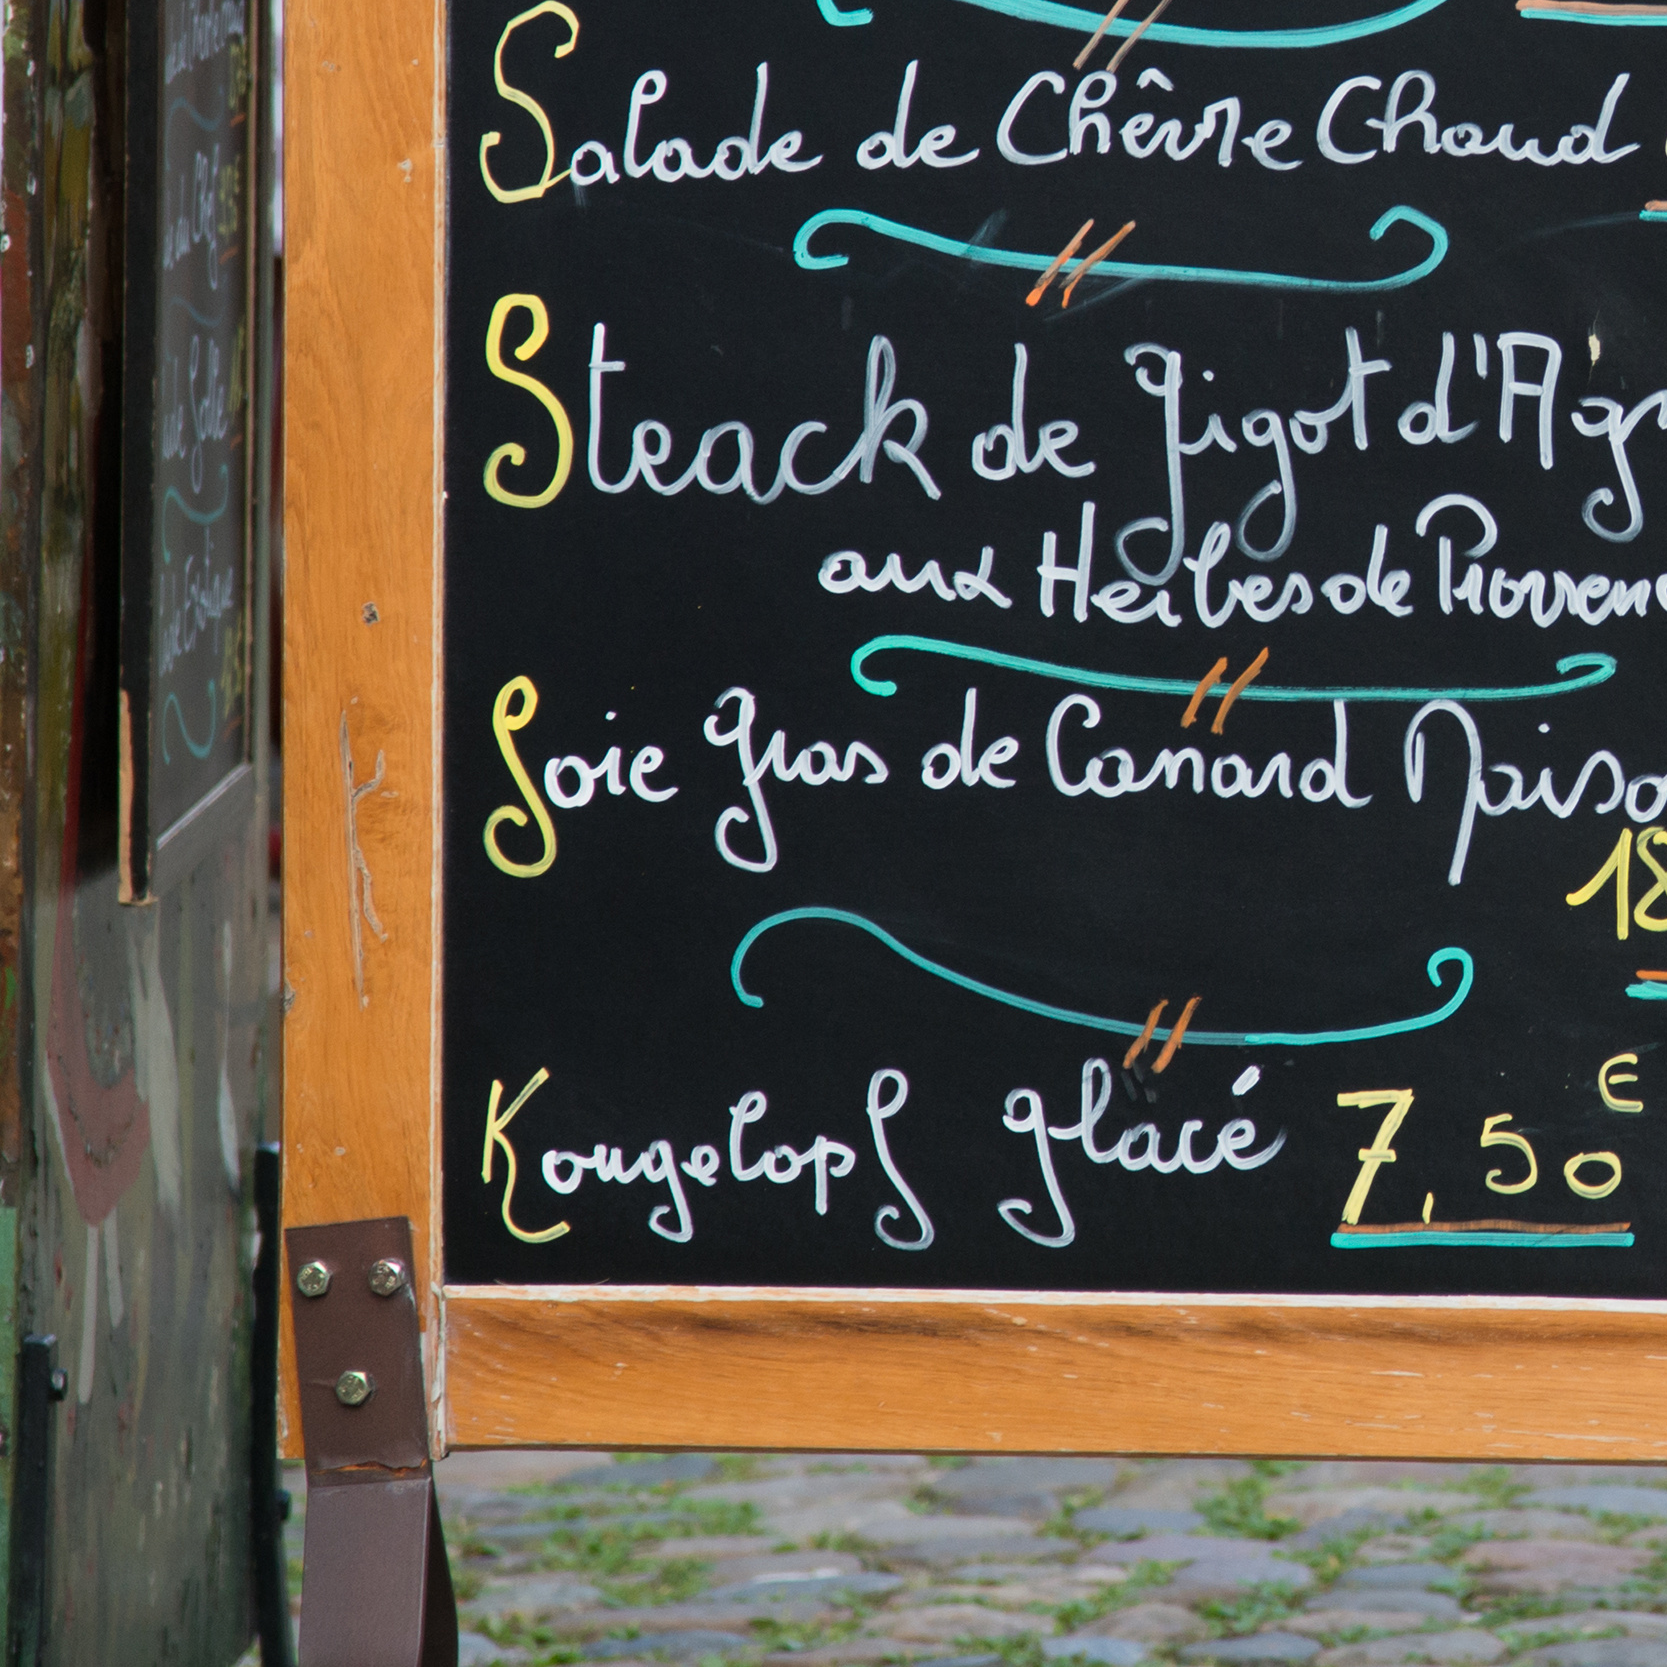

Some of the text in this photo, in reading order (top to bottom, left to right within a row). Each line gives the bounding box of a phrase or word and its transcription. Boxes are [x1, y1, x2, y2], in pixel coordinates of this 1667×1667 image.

[480, 0, 824, 204] Salade
[857, 58, 981, 171] de
[1316, 69, 1641, 168] Chaud
[484, 292, 942, 509] Steack
[972, 342, 1098, 482] de
[818, 545, 1013, 610] aux
[1321, 523, 1414, 618] de
[922, 687, 1020, 790] de
[1046, 692, 1373, 808] Canard
